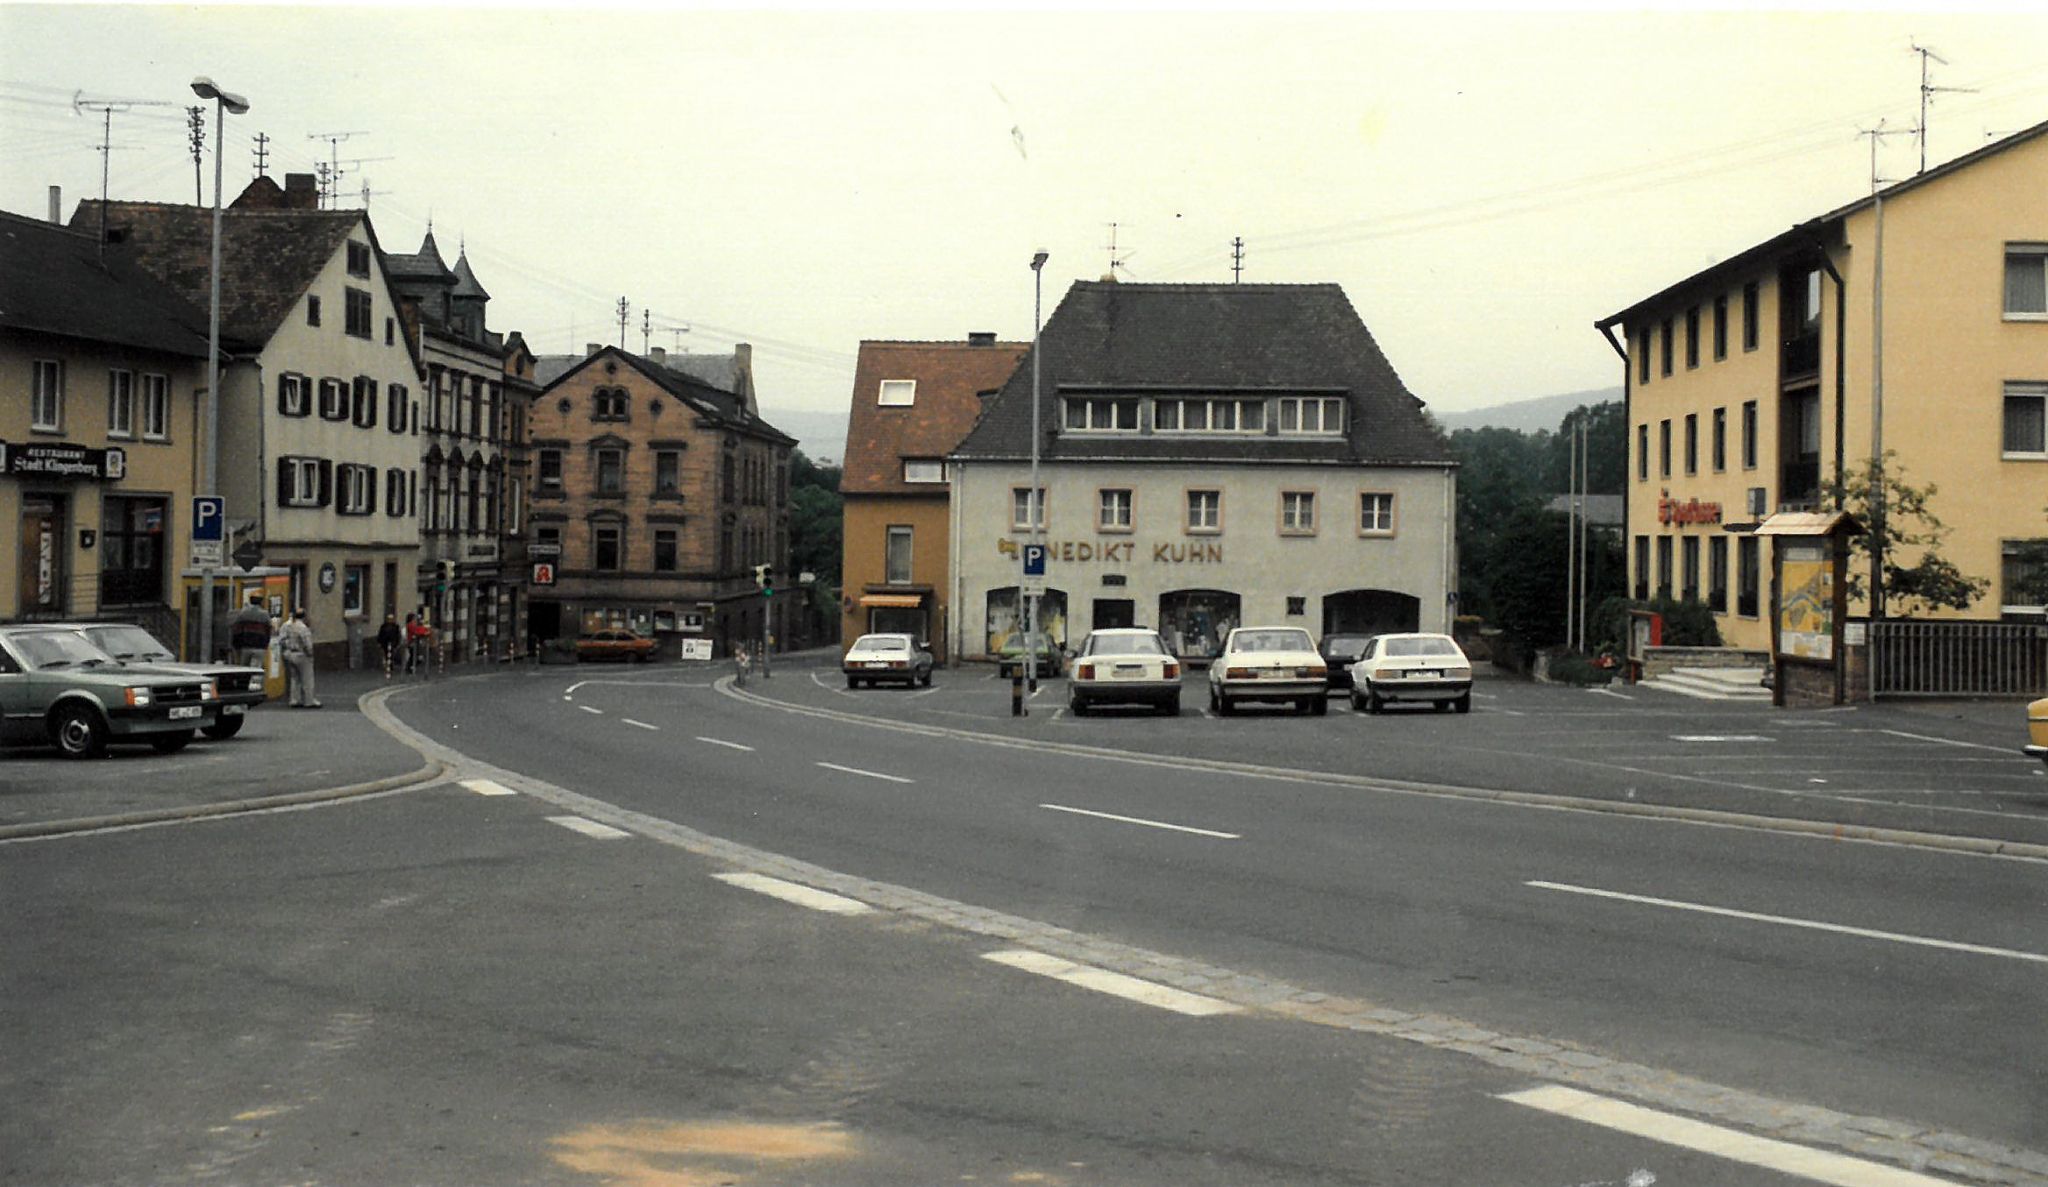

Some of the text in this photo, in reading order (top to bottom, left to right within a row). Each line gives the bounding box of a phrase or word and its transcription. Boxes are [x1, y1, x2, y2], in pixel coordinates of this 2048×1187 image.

[27, 448, 85, 459] RESTAURANT
[14, 456, 98, 476] Stadt Klingenberg
[198, 502, 216, 528] P
[1028, 547, 1041, 567] P
[1153, 543, 1222, 562] KUHN
